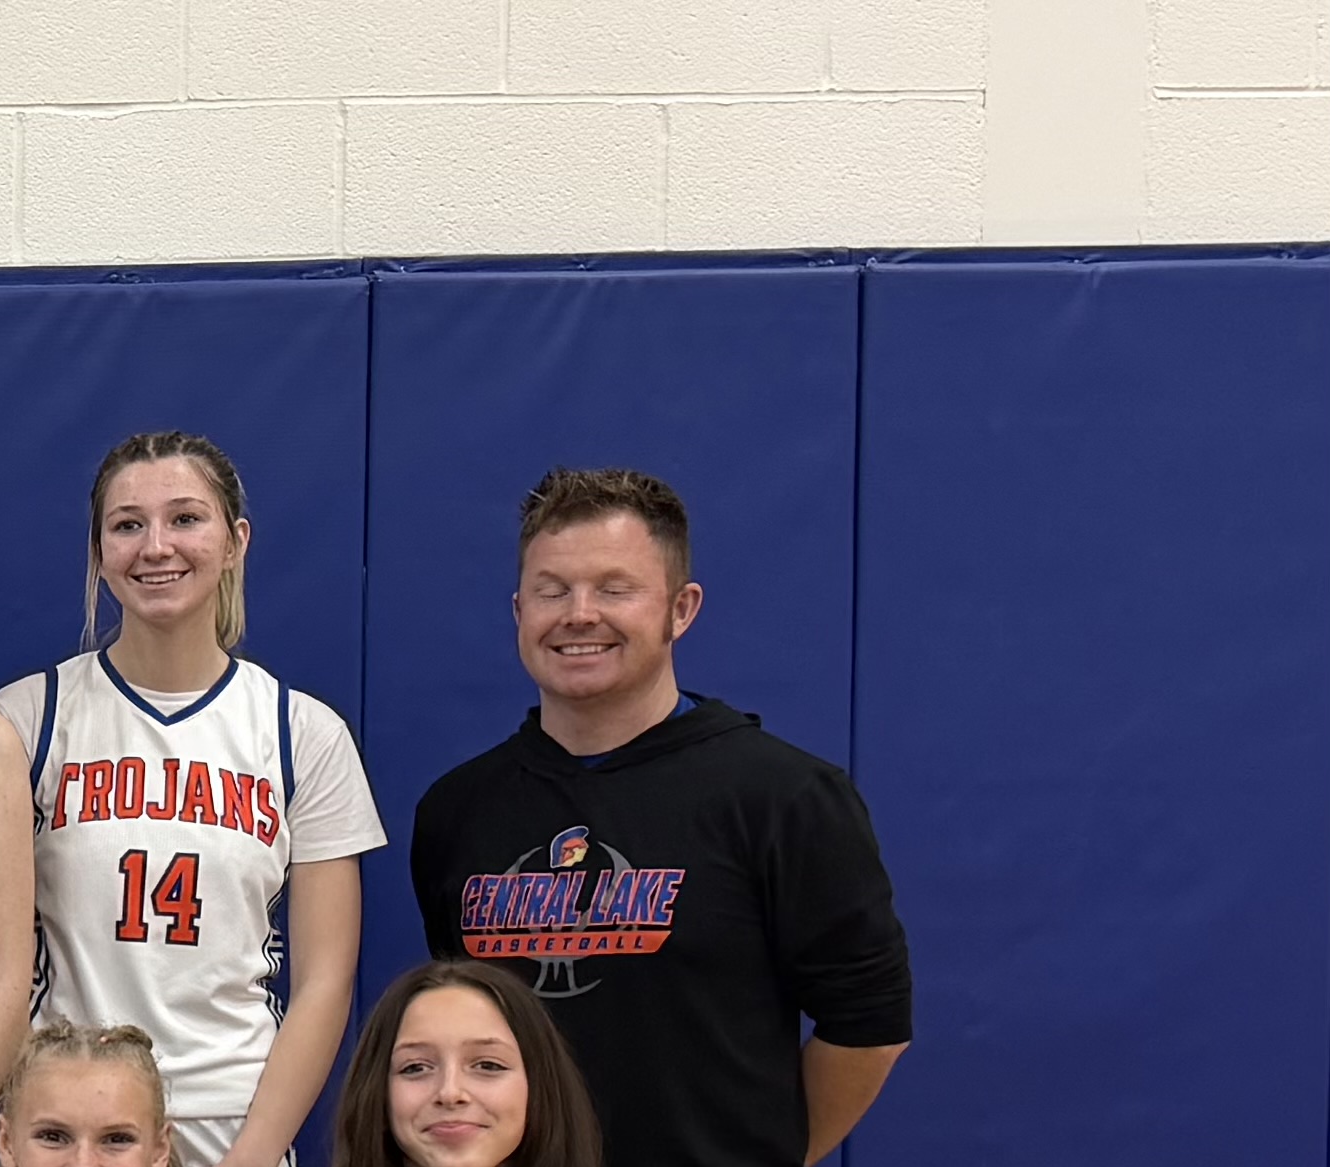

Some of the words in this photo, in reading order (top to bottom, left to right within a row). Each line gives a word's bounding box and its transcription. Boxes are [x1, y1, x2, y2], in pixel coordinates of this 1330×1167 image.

[51, 757, 280, 848] TROJANS
[115, 849, 202, 947] 14
[461, 870, 588, 930] CENTRAL
[589, 868, 686, 927] LAKE
[476, 935, 645, 953] BASKETBALL
